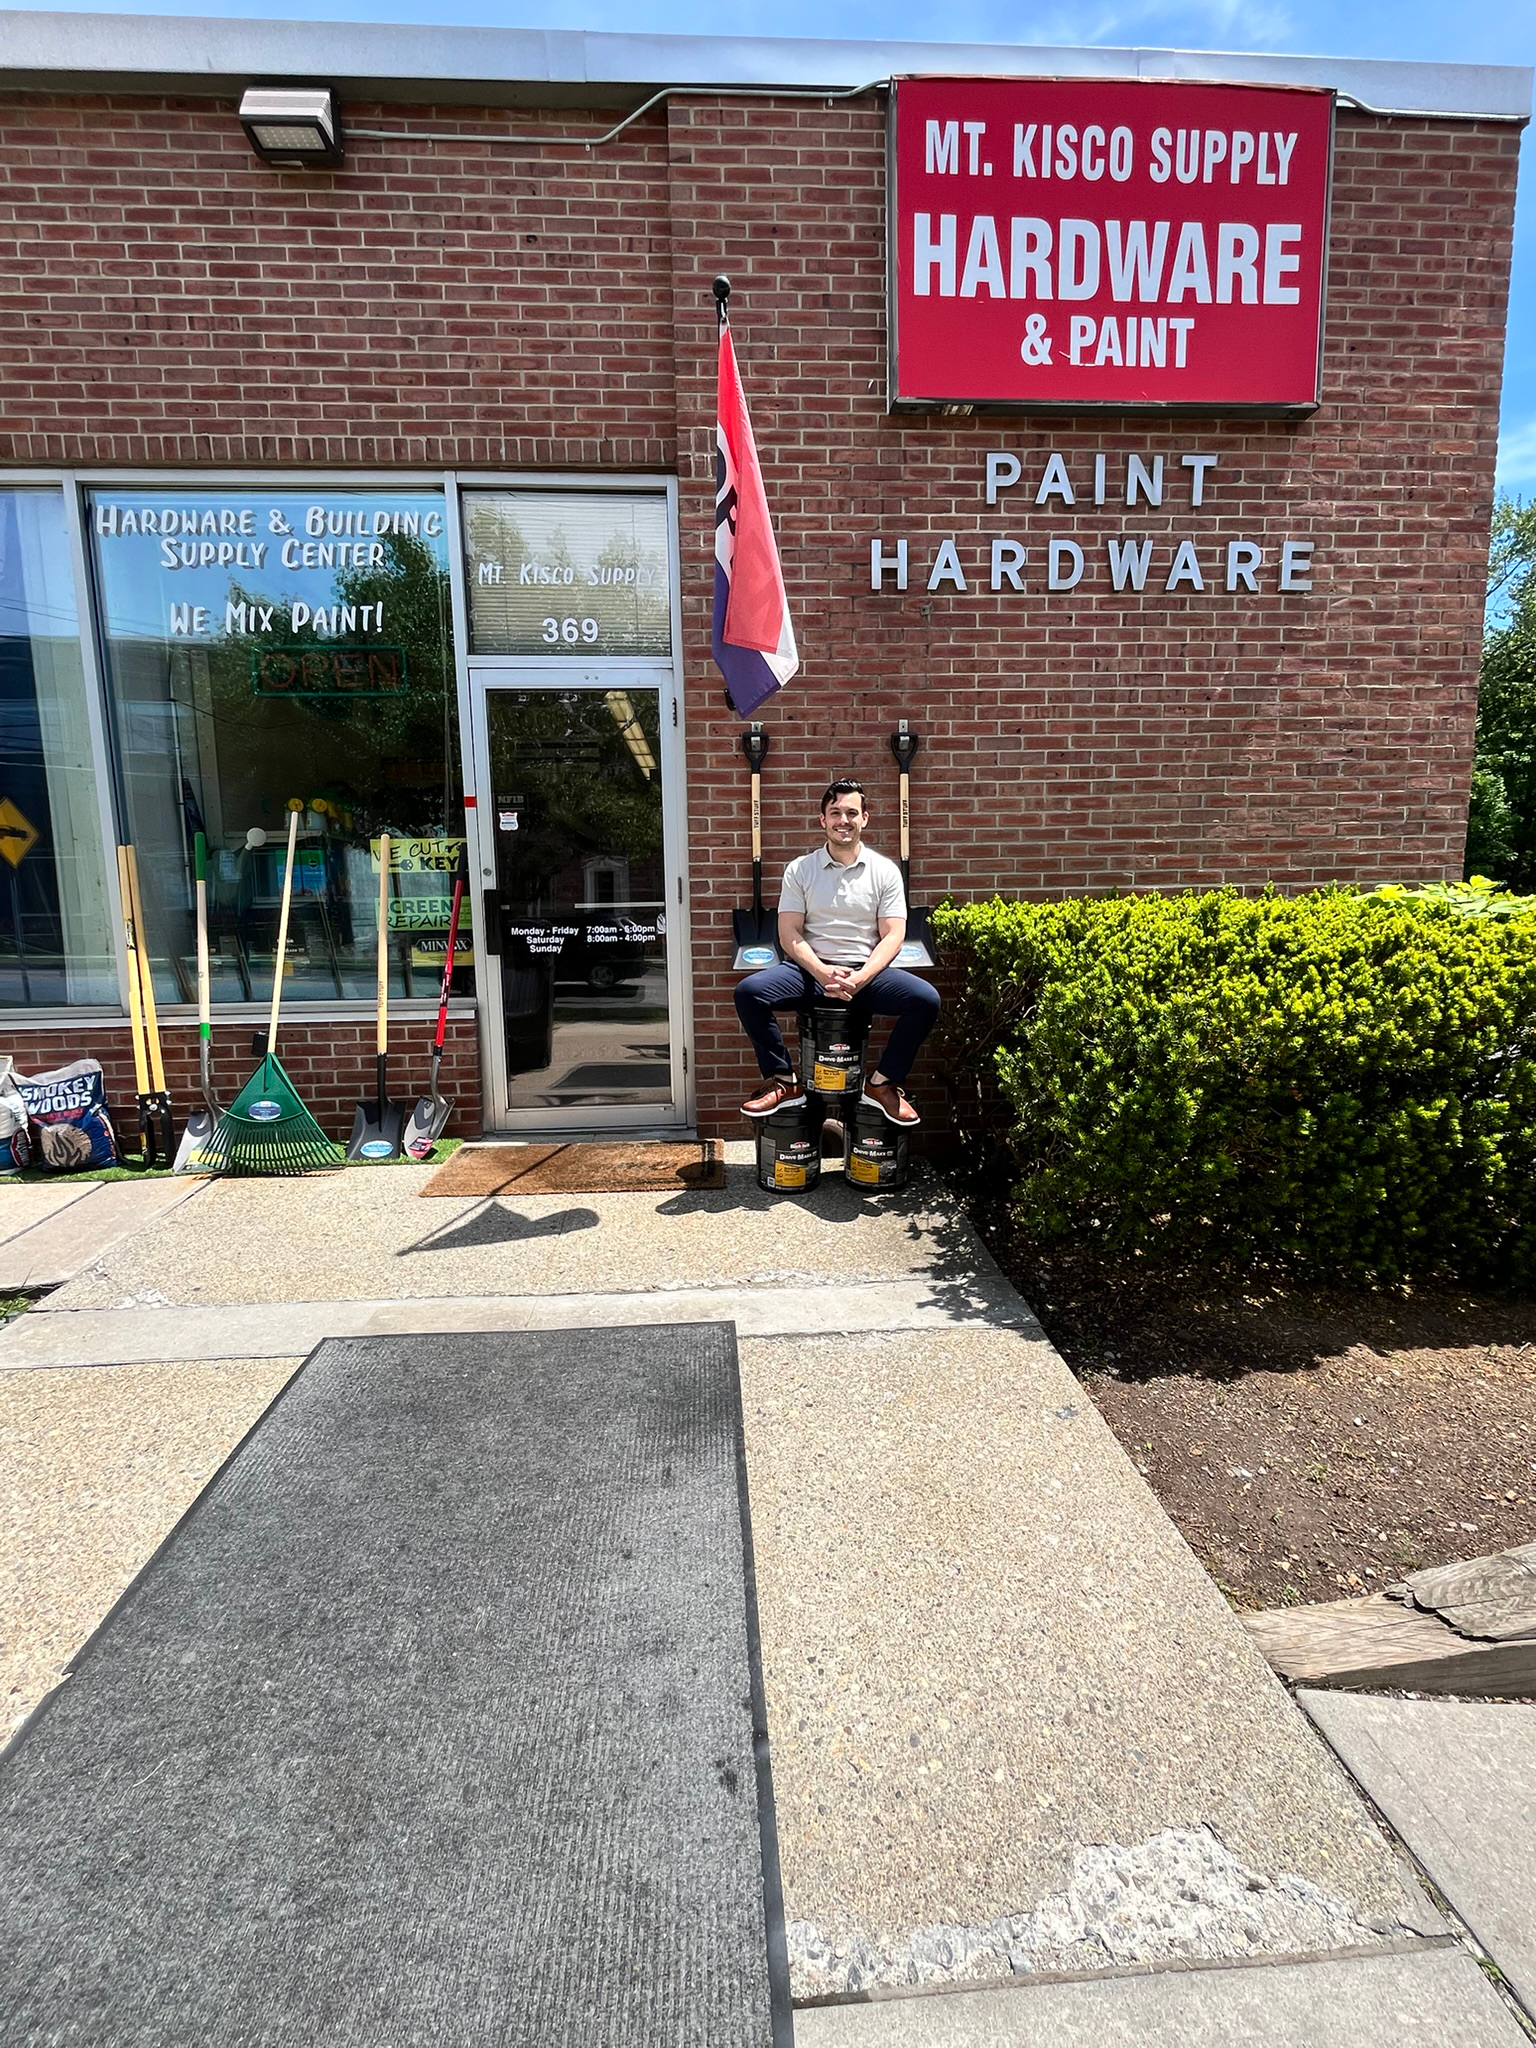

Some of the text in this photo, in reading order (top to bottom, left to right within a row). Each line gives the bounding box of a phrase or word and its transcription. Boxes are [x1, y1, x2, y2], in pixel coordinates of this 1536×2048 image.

[924, 119, 1299, 185] MT. KISCO SUPPLY
[913, 212, 1303, 305] HARDWARE
[1021, 313, 1195, 369] & PAINT
[986, 452, 1217, 506] PAINT
[96, 505, 443, 536] HARDWARE & BUILDING
[160, 537, 385, 569] SUPPLY CENTER
[870, 538, 1316, 592] HARDWARE
[519, 562, 574, 586] KISCO
[587, 566, 656, 587] SUPPLY
[169, 601, 384, 634] WE MIX PAINT!
[542, 617, 599, 643] 369
[260, 652, 401, 689] OPEN
[373, 840, 444, 862] E CUT
[380, 899, 453, 914] CREEN
[511, 927, 544, 936] Monday
[552, 926, 579, 936] Friday
[586, 925, 617, 934] 7:00am
[526, 936, 564, 945] Saturday
[586, 935, 617, 943] 8:00am
[625, 934, 655, 943] 4:00pm
[529, 944, 562, 954] Sunday
[21, 1075, 96, 1100] SMOKEY
[26, 1091, 93, 1115] WOODS
